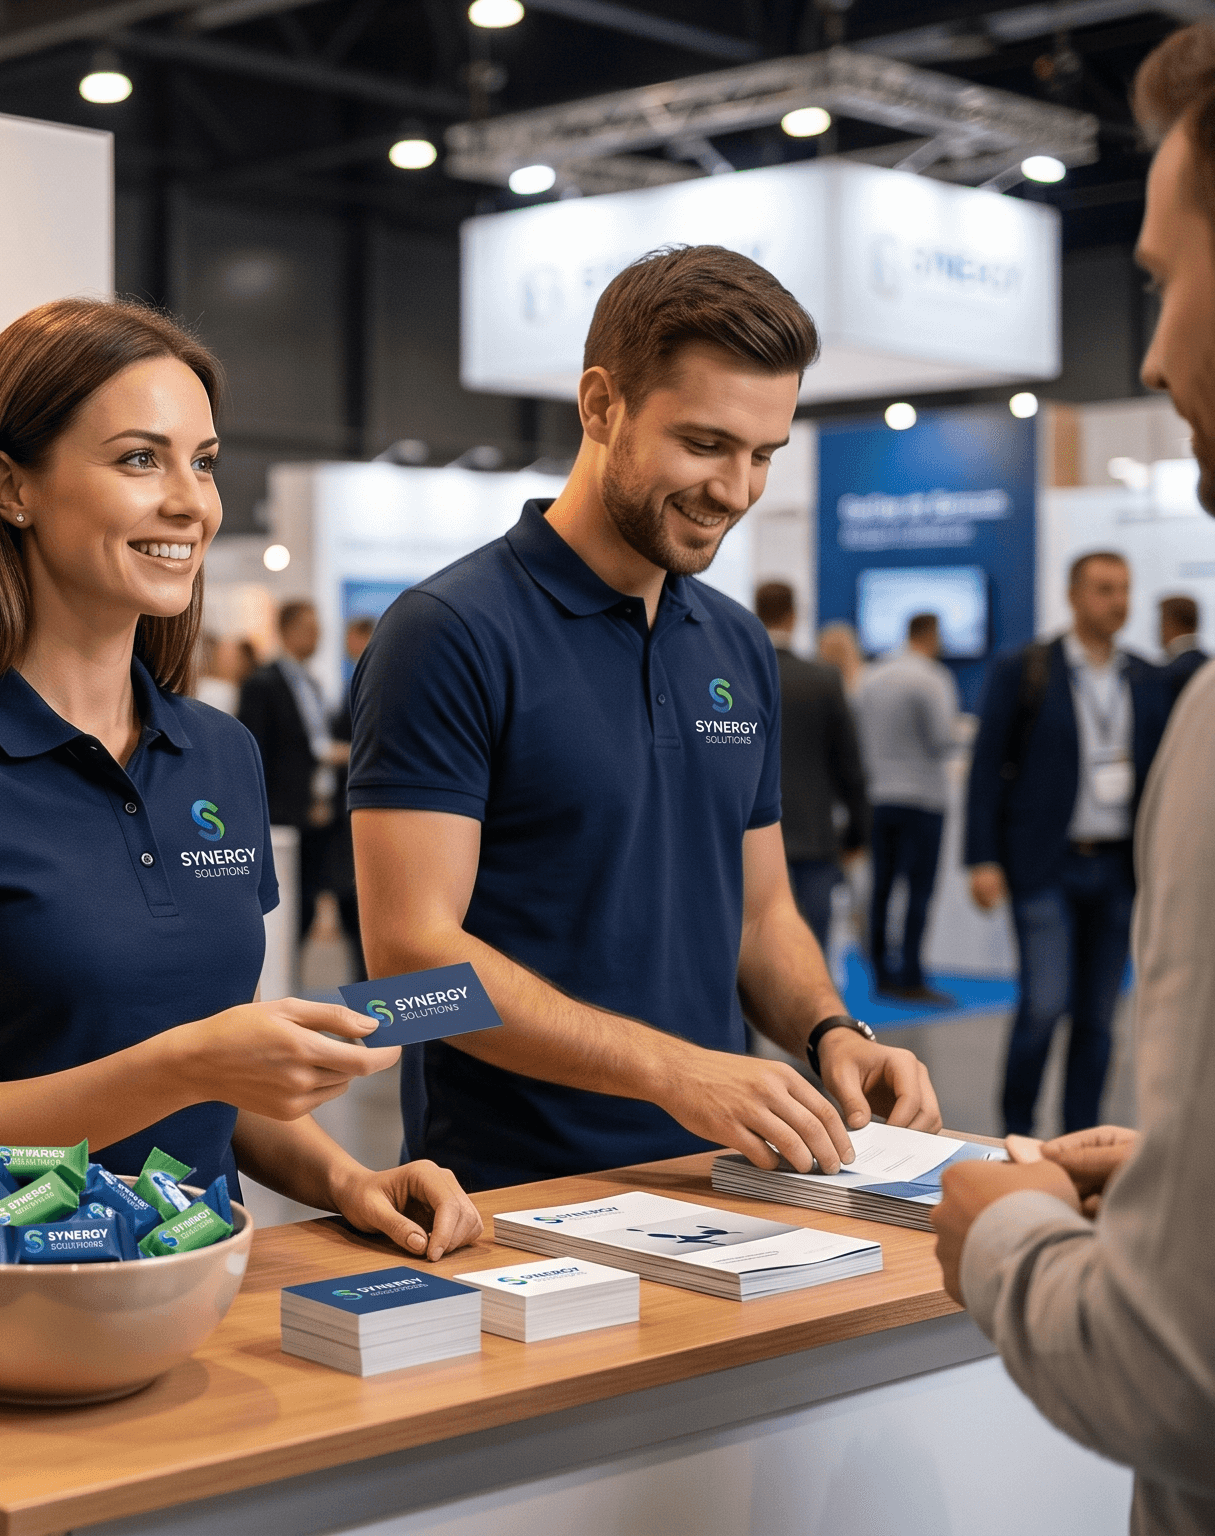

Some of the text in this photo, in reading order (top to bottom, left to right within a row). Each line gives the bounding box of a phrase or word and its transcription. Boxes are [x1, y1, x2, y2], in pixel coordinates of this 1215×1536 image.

[695, 720, 758, 734] SYNERGY
[705, 735, 751, 744] SOLUTIONS
[180, 848, 255, 867] SYNERGY
[194, 866, 250, 878] SOLUTIONS
[395, 986, 467, 1011] SYNERGY
[400, 1003, 460, 1021] SOLUTIONS
[47, 1228, 108, 1241] SYNERGY
